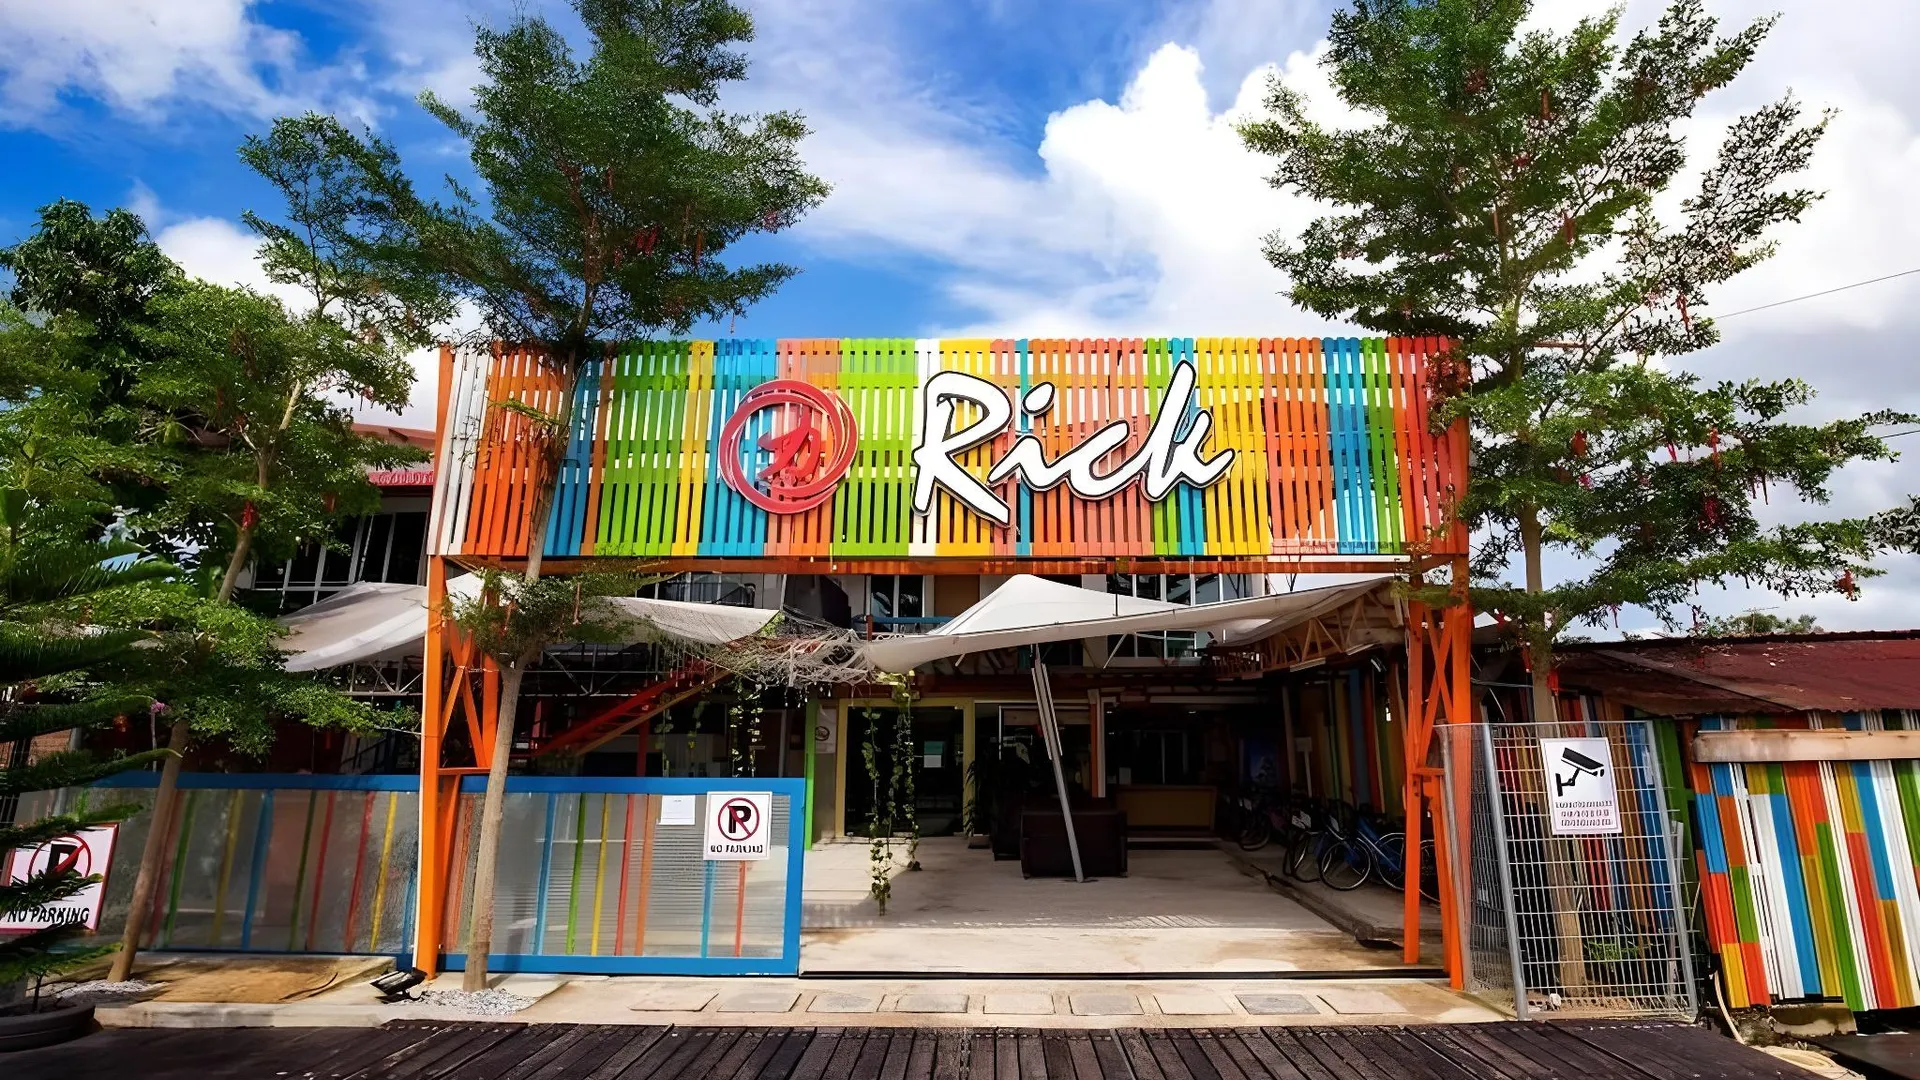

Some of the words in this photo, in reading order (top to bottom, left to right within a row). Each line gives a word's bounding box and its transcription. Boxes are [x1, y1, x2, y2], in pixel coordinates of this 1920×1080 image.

[911, 358, 1236, 528] Rick
[7, 907, 28, 923] NO
[30, 907, 90, 924] PARKING
